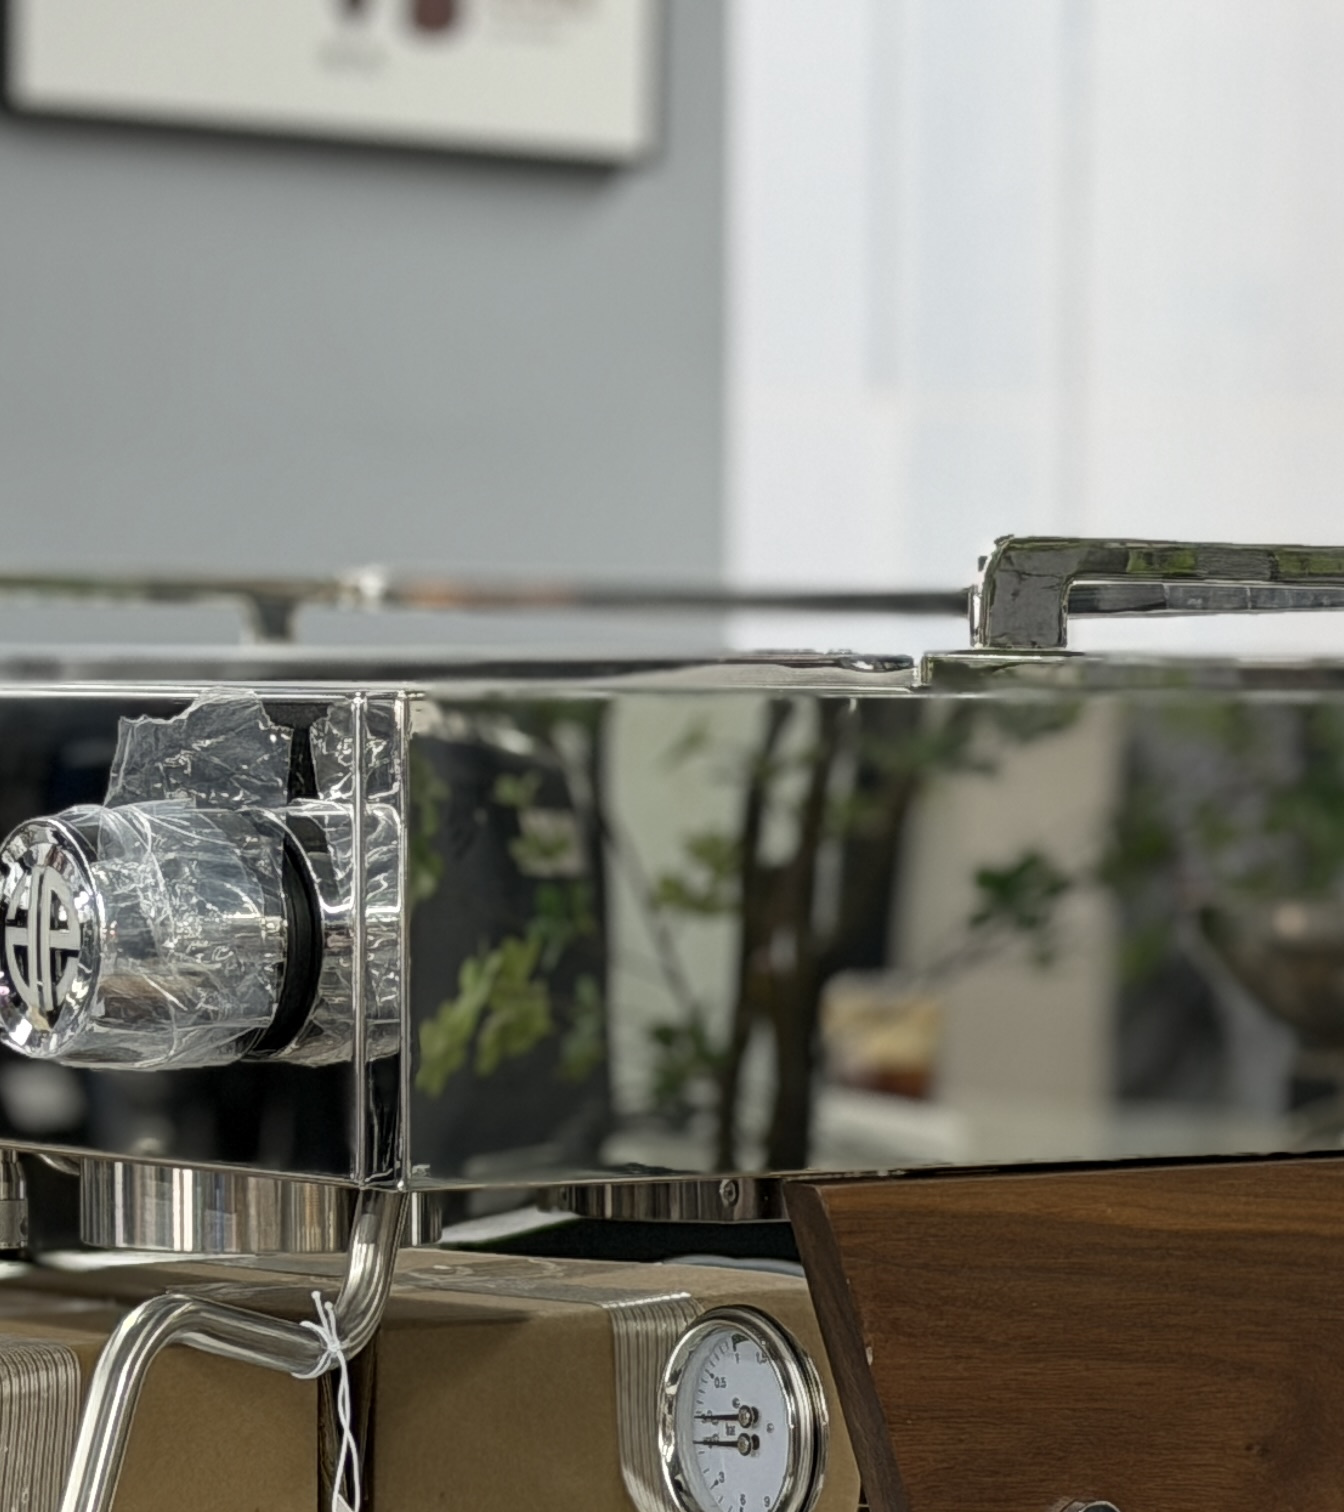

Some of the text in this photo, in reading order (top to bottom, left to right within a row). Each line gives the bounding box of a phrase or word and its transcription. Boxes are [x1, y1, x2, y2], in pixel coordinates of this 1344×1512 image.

[713, 1377, 727, 1389] 0.5
[725, 1422, 736, 1436] bar
[718, 1471, 726, 1484] 3
[739, 1493, 747, 1506] 6
[763, 1495, 771, 1508] 9
